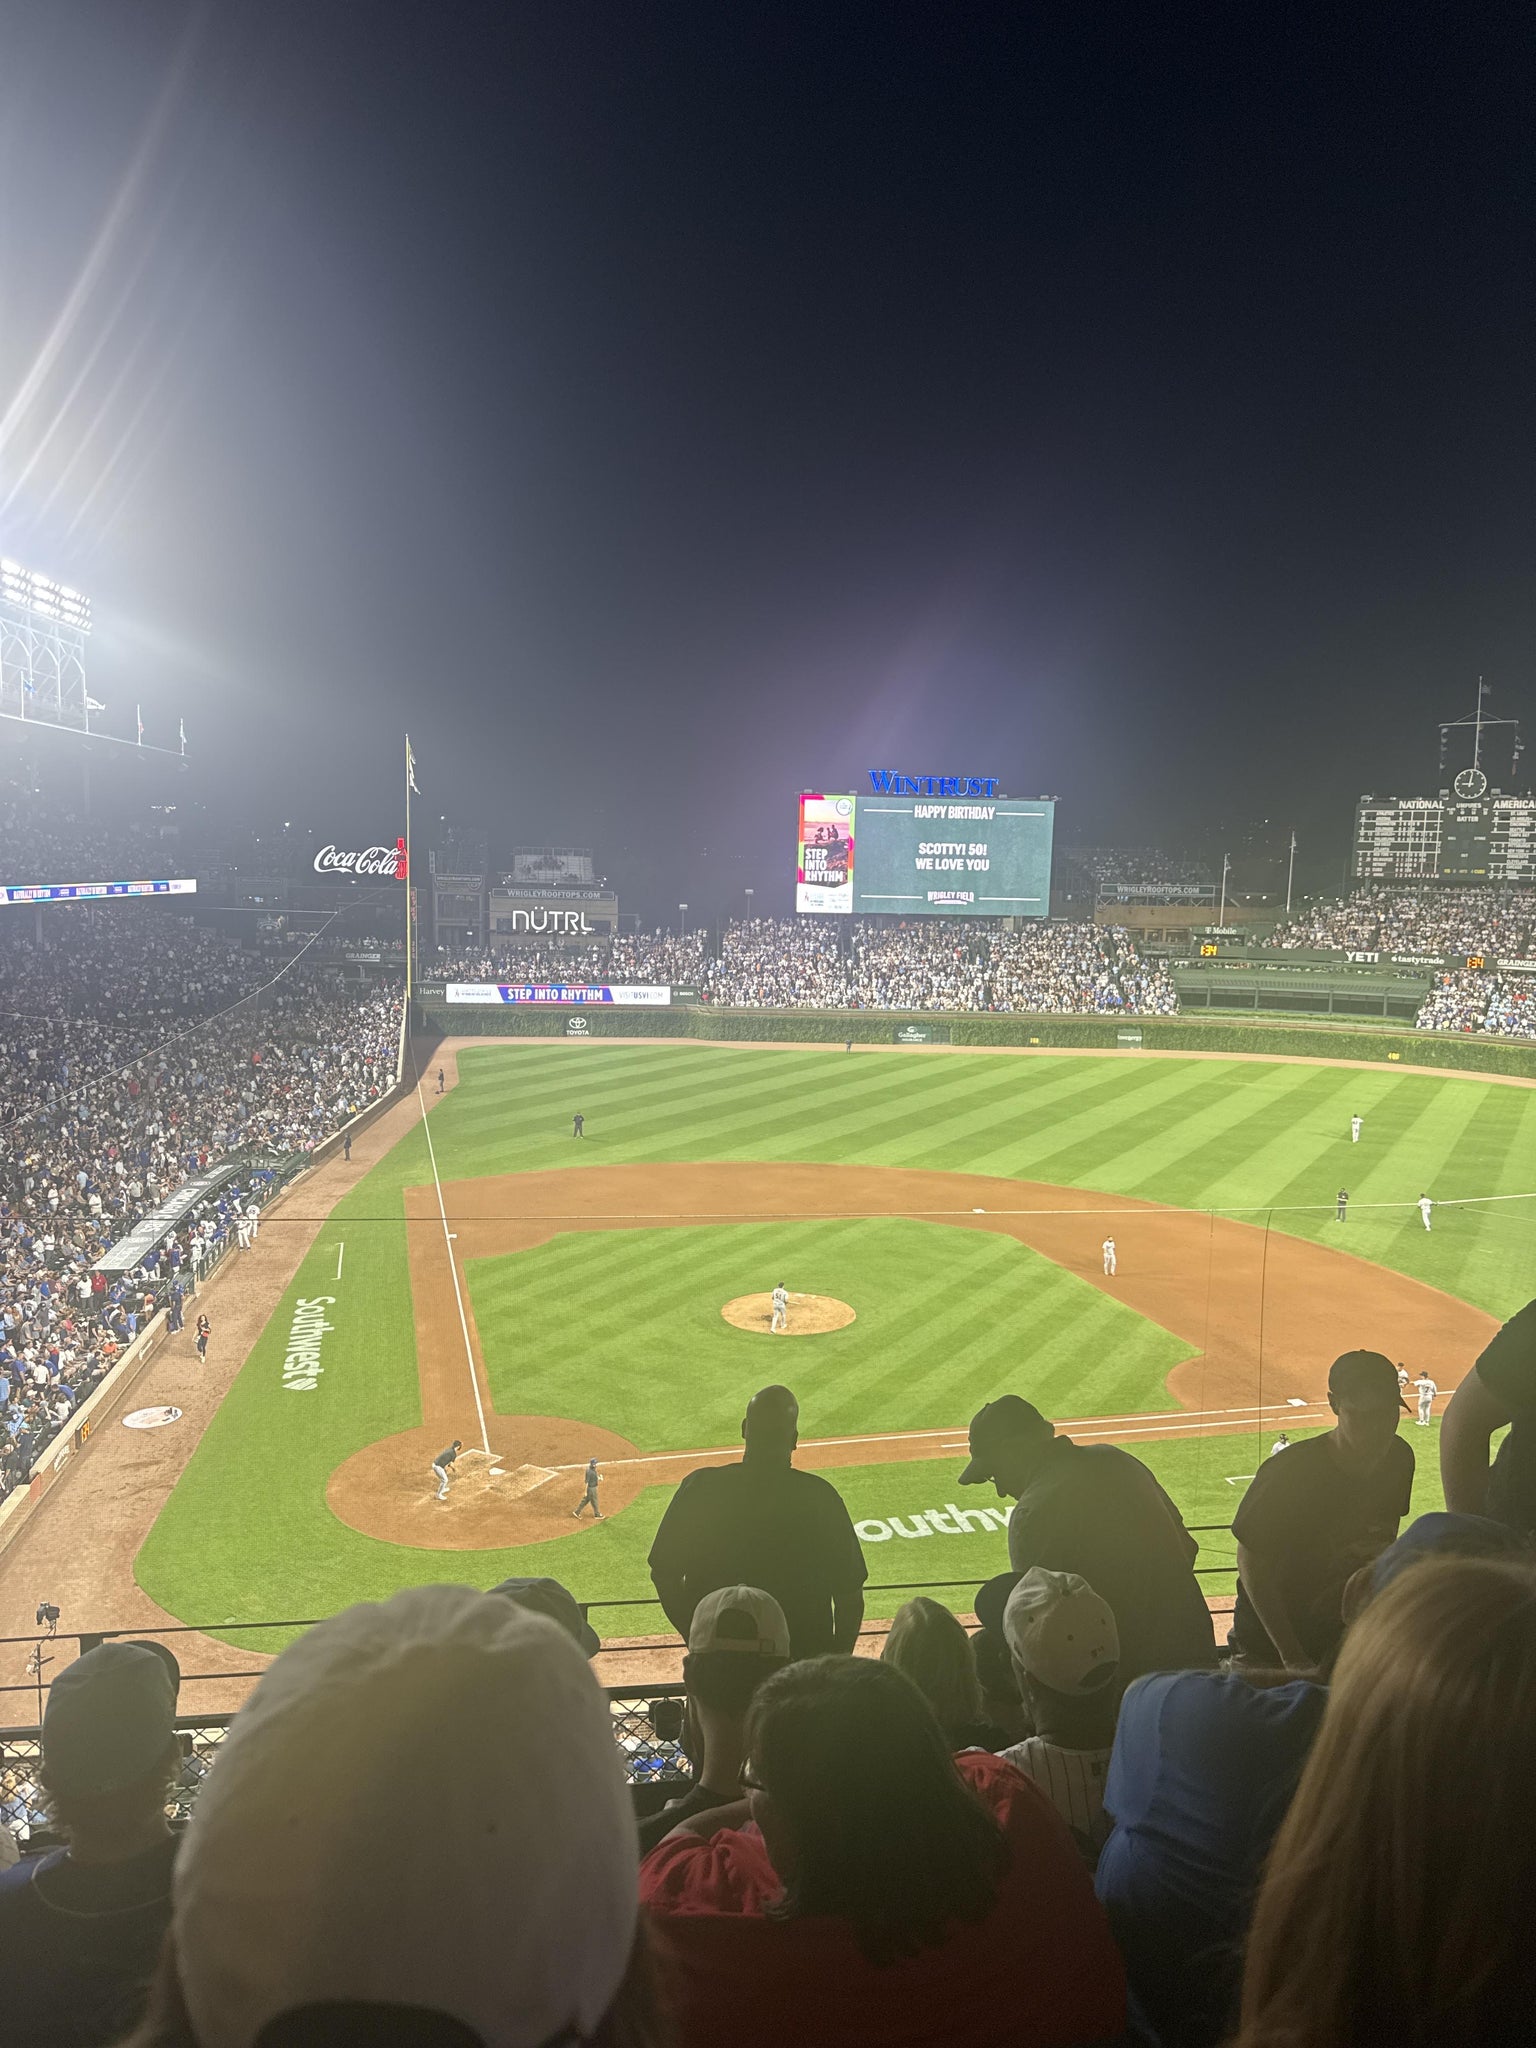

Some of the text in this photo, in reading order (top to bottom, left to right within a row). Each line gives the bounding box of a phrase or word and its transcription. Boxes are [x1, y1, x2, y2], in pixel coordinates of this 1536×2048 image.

[1399, 801, 1444, 809] NATIONAL
[1493, 800, 1536, 809] AMERICA
[914, 805, 995, 820] HAPPY BIRTHDAY
[805, 848, 828, 861] STEP
[918, 843, 987, 856] SCOTTY! 50!
[313, 844, 401, 875] Coca-Cola
[805, 860, 827, 871] INTO
[915, 858, 990, 871] WE LOVE YOU
[805, 870, 844, 882] RHYTHM
[928, 891, 974, 902] WRIGLEY FIELD
[1346, 952, 1380, 962] YETI
[1398, 956, 1444, 965] tastytrade
[1467, 957, 1484, 969] 1:34
[420, 982, 445, 996] Harvey
[508, 988, 603, 1001] STEP INTO RHYTHM
[282, 1296, 336, 1379] Southwest
